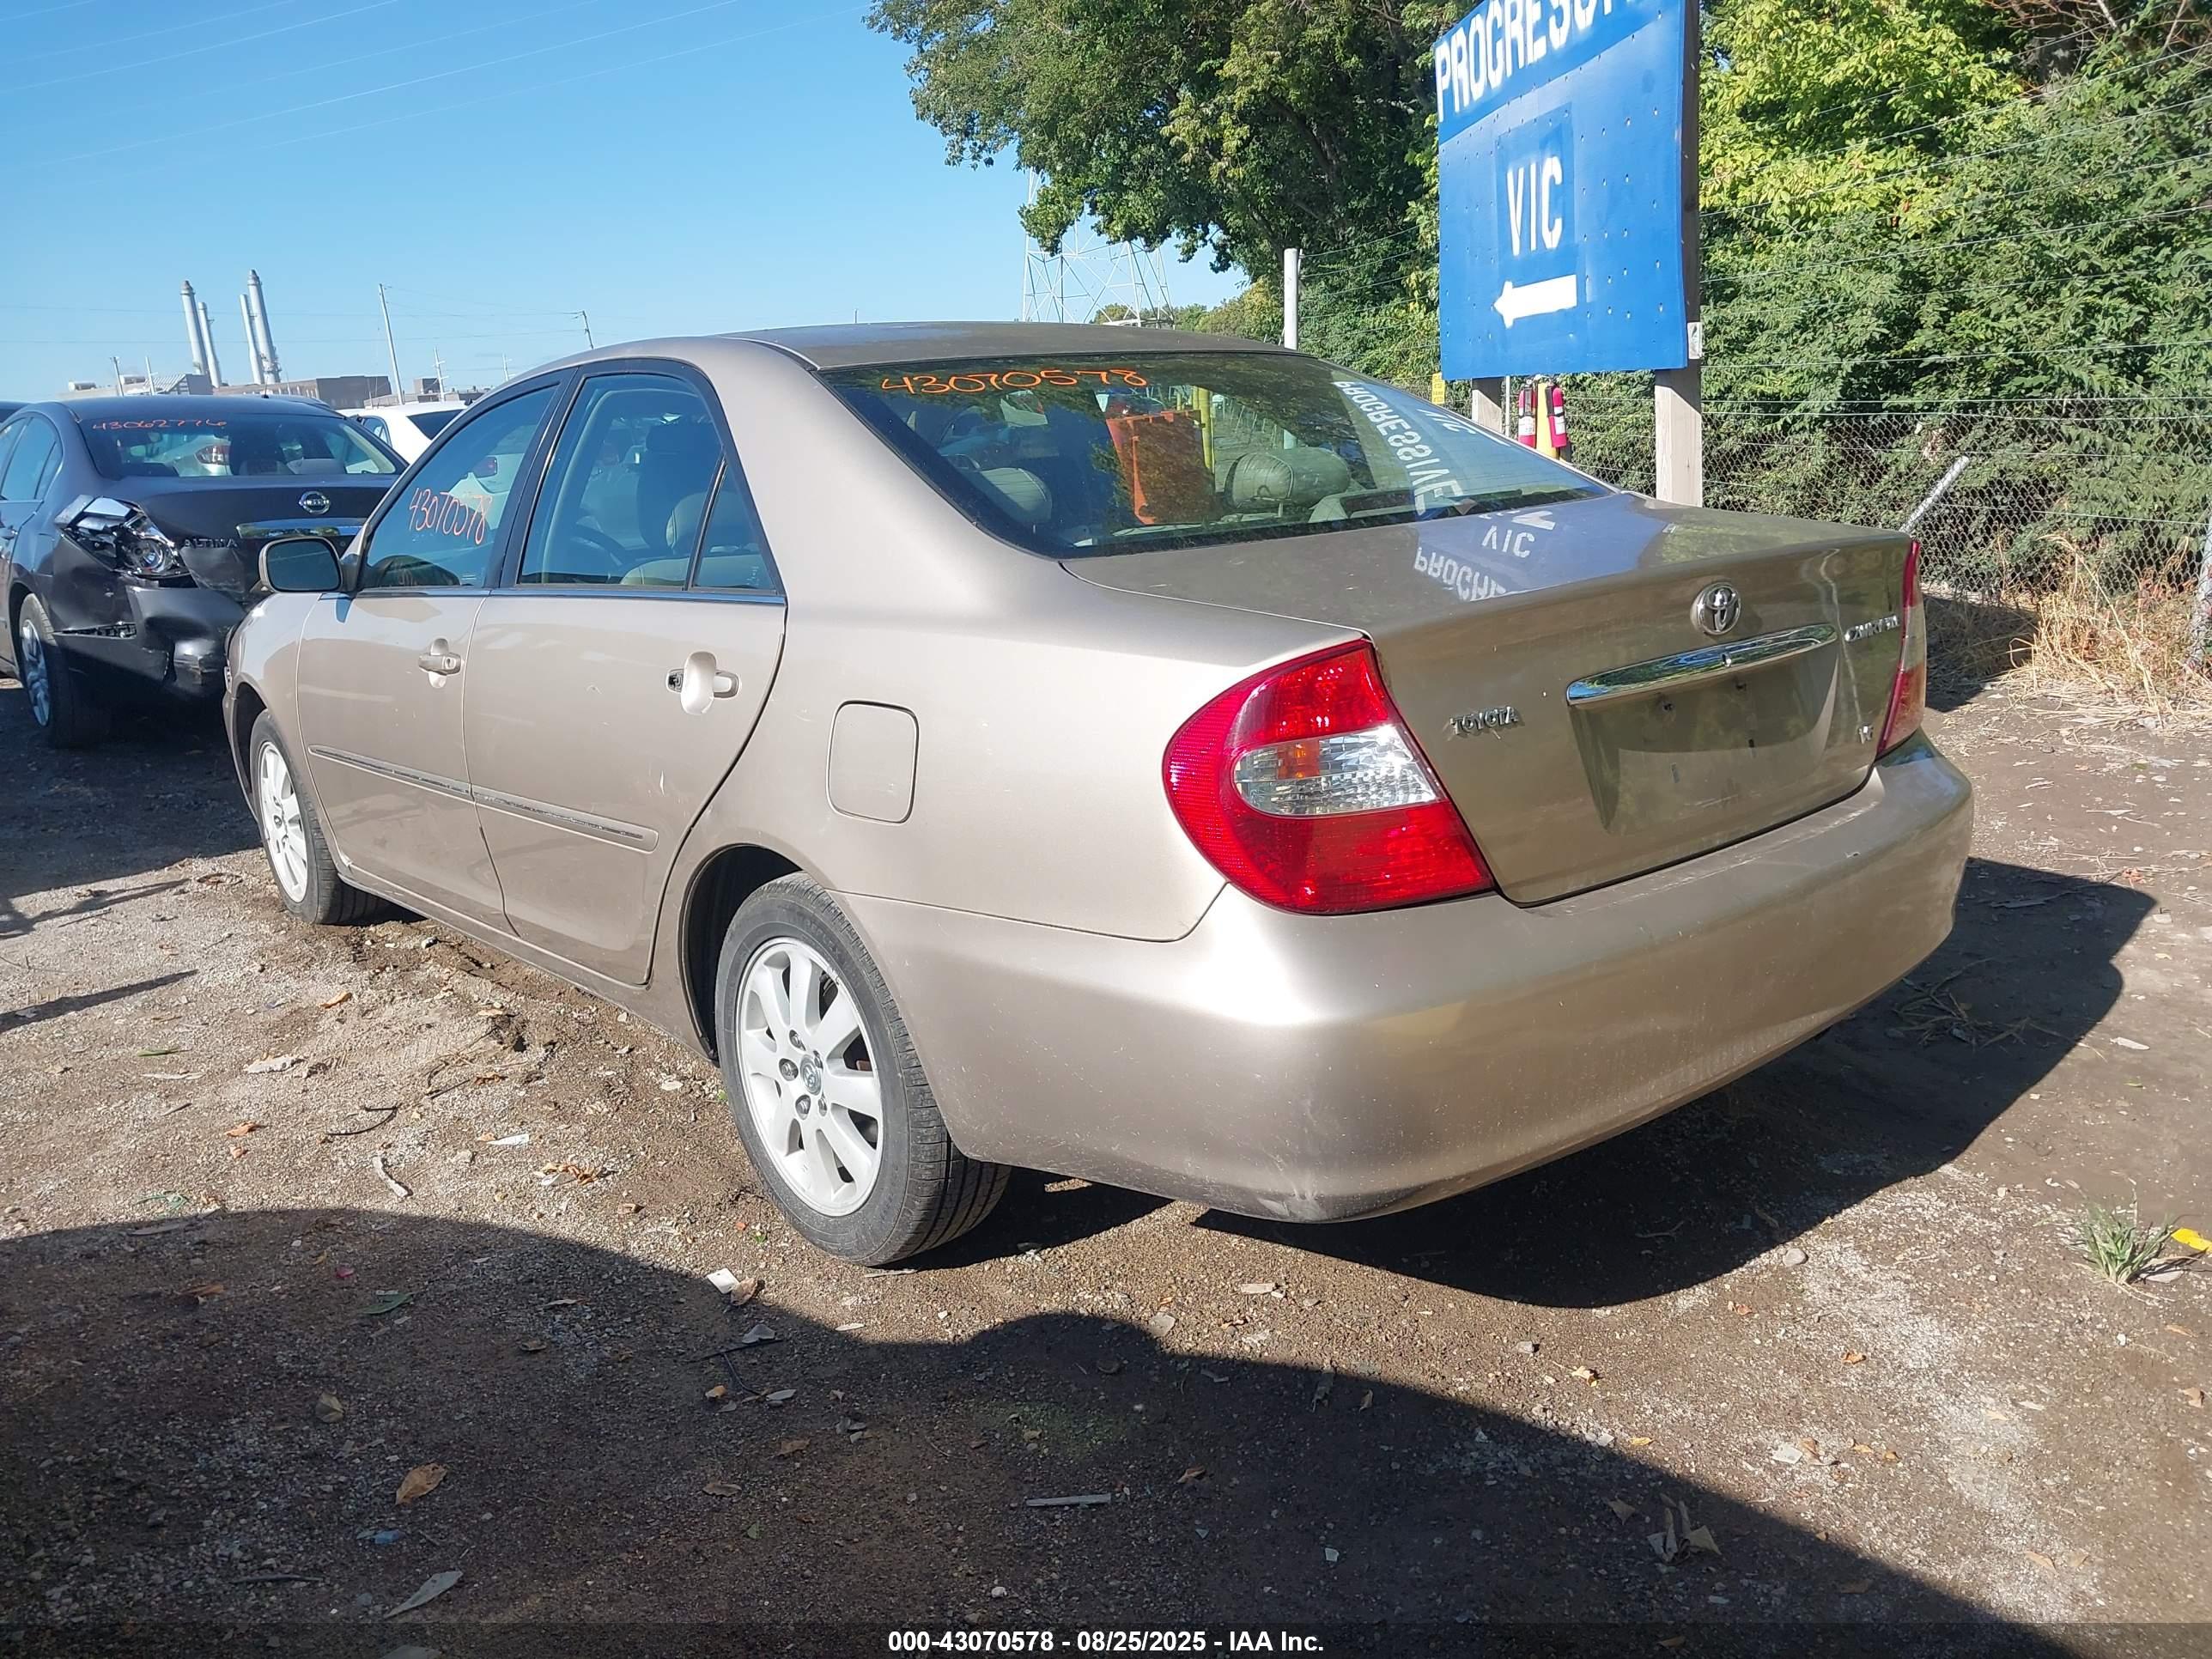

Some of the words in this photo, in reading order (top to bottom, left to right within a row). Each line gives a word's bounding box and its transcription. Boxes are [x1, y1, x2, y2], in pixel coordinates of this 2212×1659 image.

[1507, 156, 1562, 256] VIC
[882, 368, 1148, 394] 43070578
[1449, 706, 1519, 735] TOYOTA
